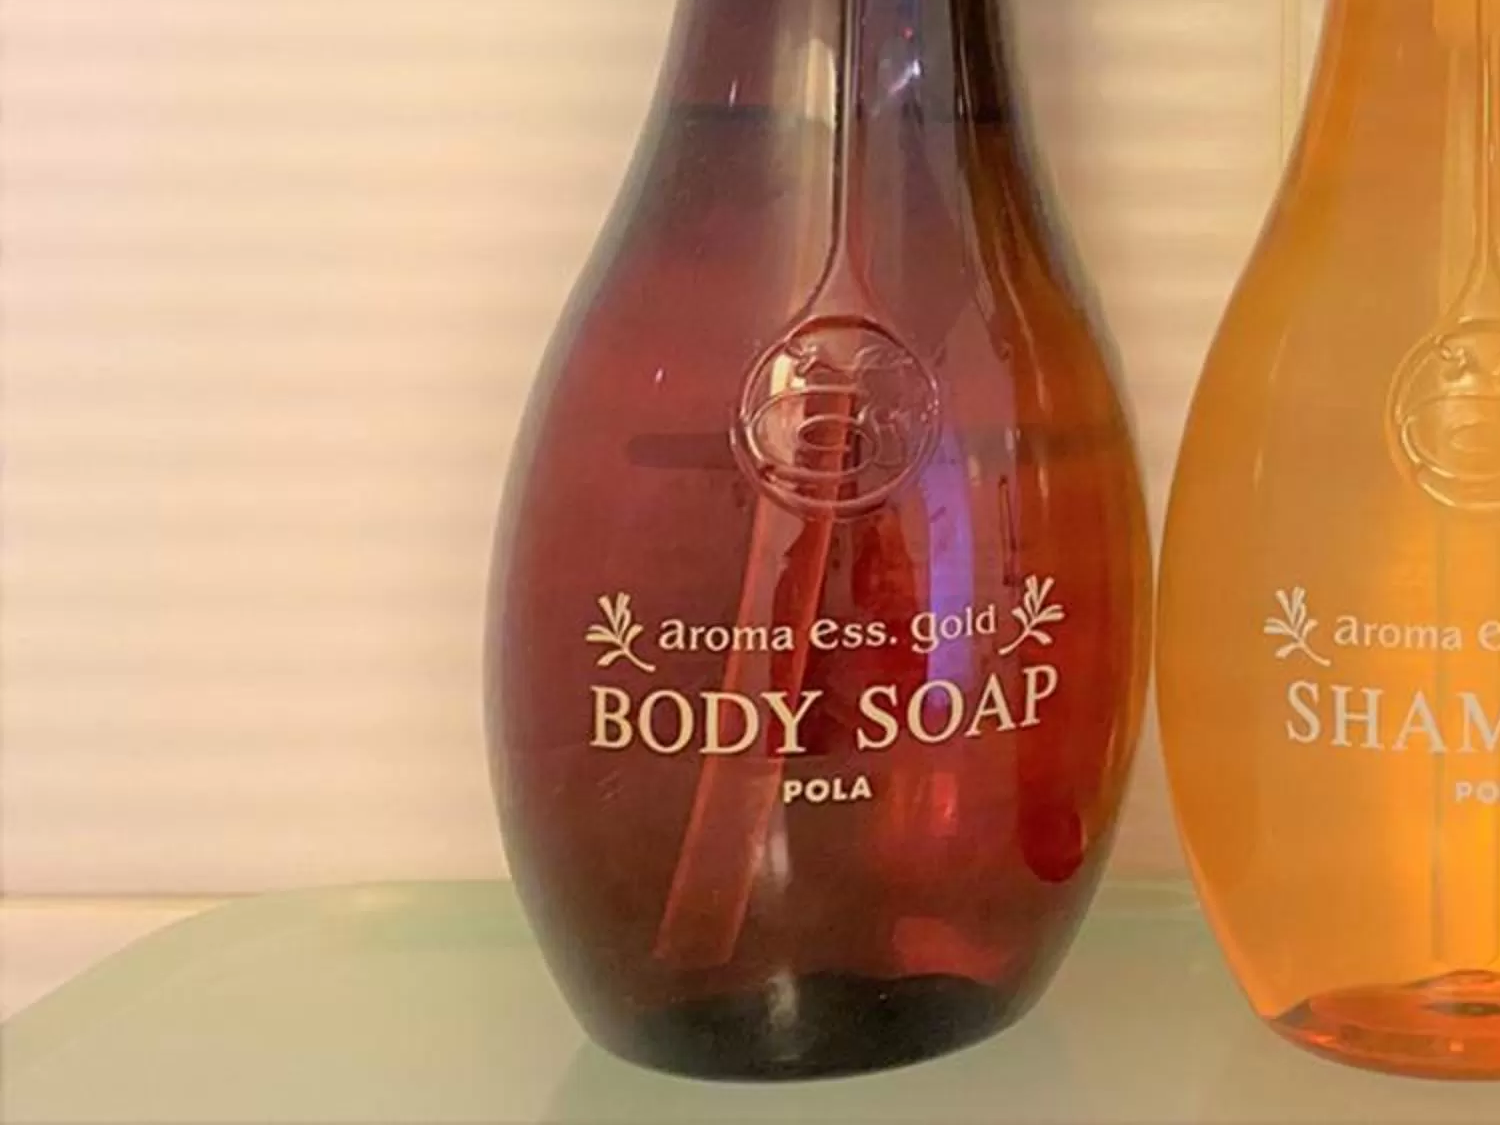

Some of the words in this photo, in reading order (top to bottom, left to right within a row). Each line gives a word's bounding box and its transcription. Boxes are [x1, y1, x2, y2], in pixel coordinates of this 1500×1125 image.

[659, 618, 795, 652] aroma
[809, 617, 898, 650] ess.
[910, 604, 997, 654] gold
[1333, 614, 1463, 651] aroma
[589, 684, 823, 755] BODY
[856, 664, 1059, 752] SOAP
[783, 776, 872, 804] POLA
